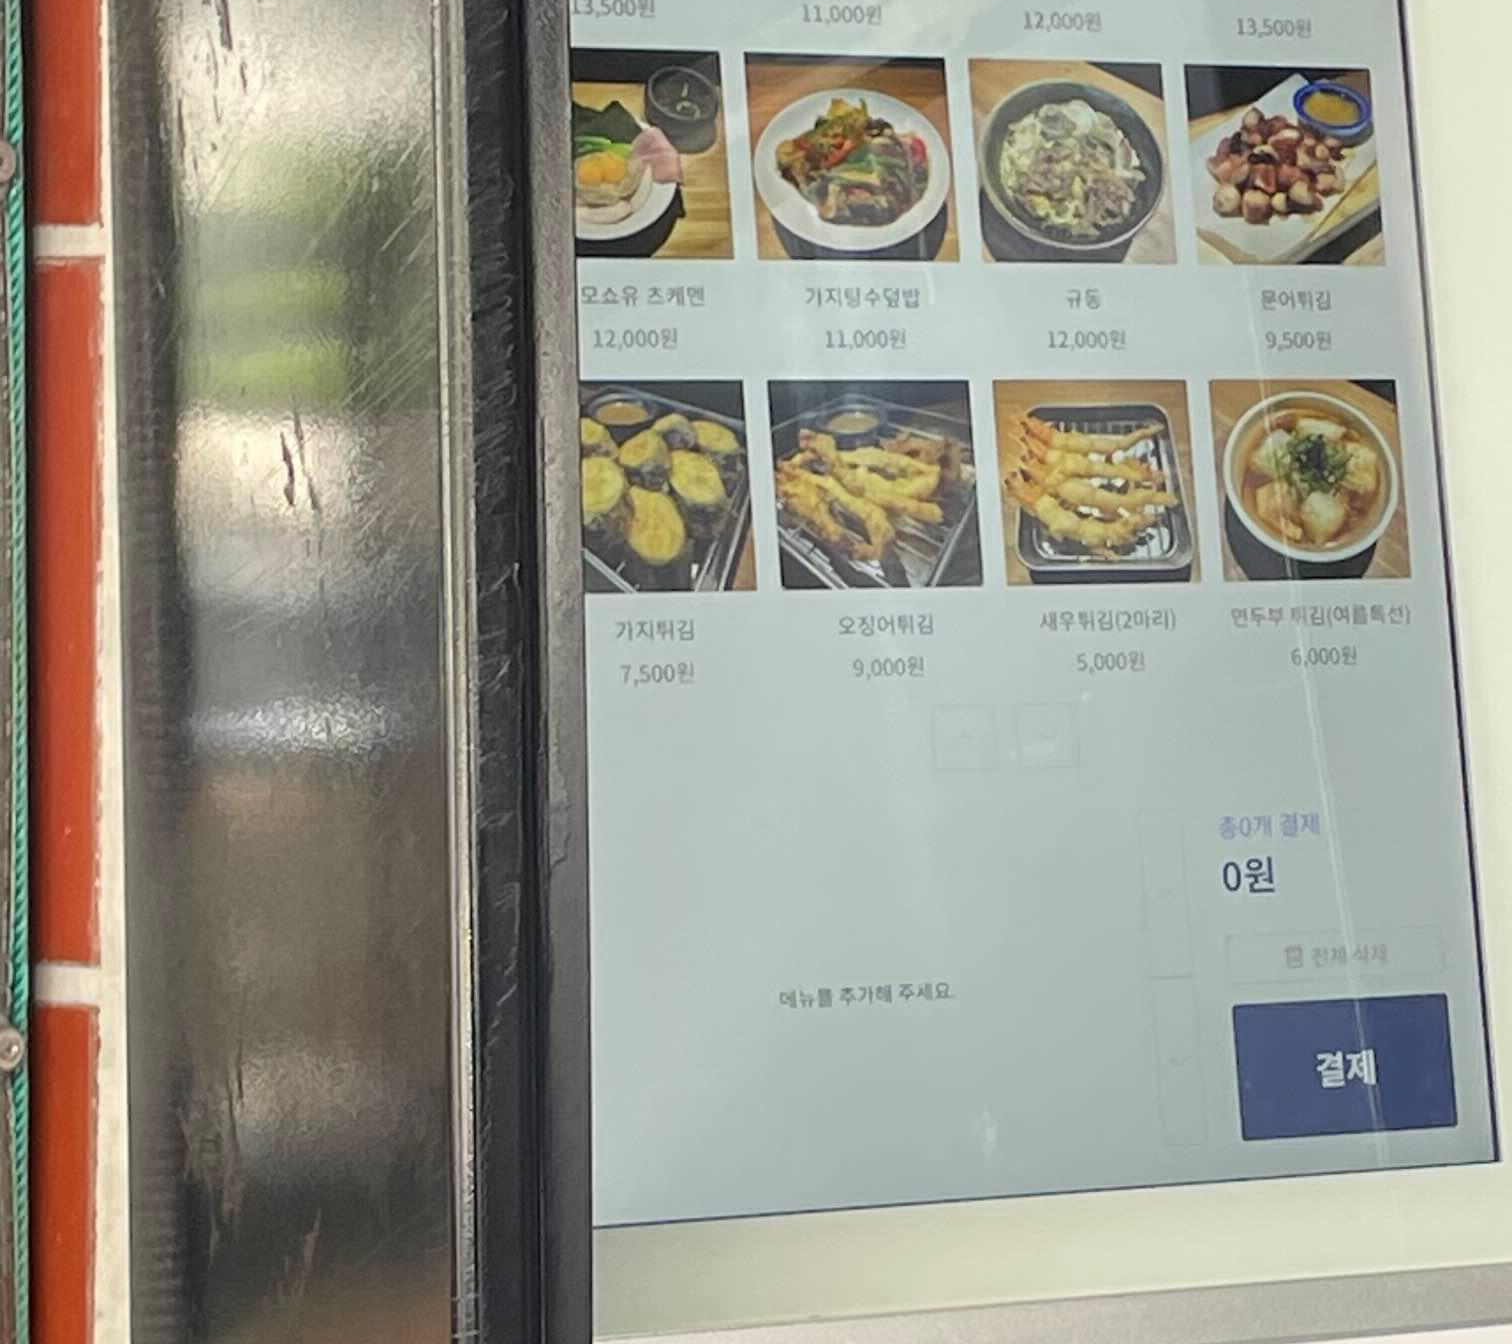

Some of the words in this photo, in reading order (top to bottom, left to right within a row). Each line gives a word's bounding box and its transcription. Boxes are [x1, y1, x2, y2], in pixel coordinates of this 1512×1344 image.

[802, 3, 883, 26] 11,000원
[1022, 10, 1102, 34] 12,000원
[1235, 17, 1312, 40] 13,500원
[1066, 288, 1101, 310] 규동
[1261, 289, 1333, 311] 문어튀김
[592, 328, 678, 351] 12,000원
[825, 328, 907, 350] 11,000원
[1047, 329, 1127, 351] 12,000원
[1265, 330, 1333, 352] 9,500원
[615, 618, 696, 642] 가지튀김
[838, 613, 935, 637] 오징어튀김
[1039, 607, 1177, 632] 새우튀김(2마리)
[852, 655, 925, 680] 9,000원
[1076, 651, 1145, 675] 5,000원
[1290, 644, 1358, 669] 6,000원
[620, 662, 696, 687] 7,500원
[1217, 814, 1273, 840] 총0개
[1279, 811, 1321, 838] 결제
[1222, 855, 1276, 894] 0원
[778, 987, 833, 1009] 메뉴를
[839, 984, 893, 1006] 추가해
[1315, 1047, 1378, 1089] 결제
